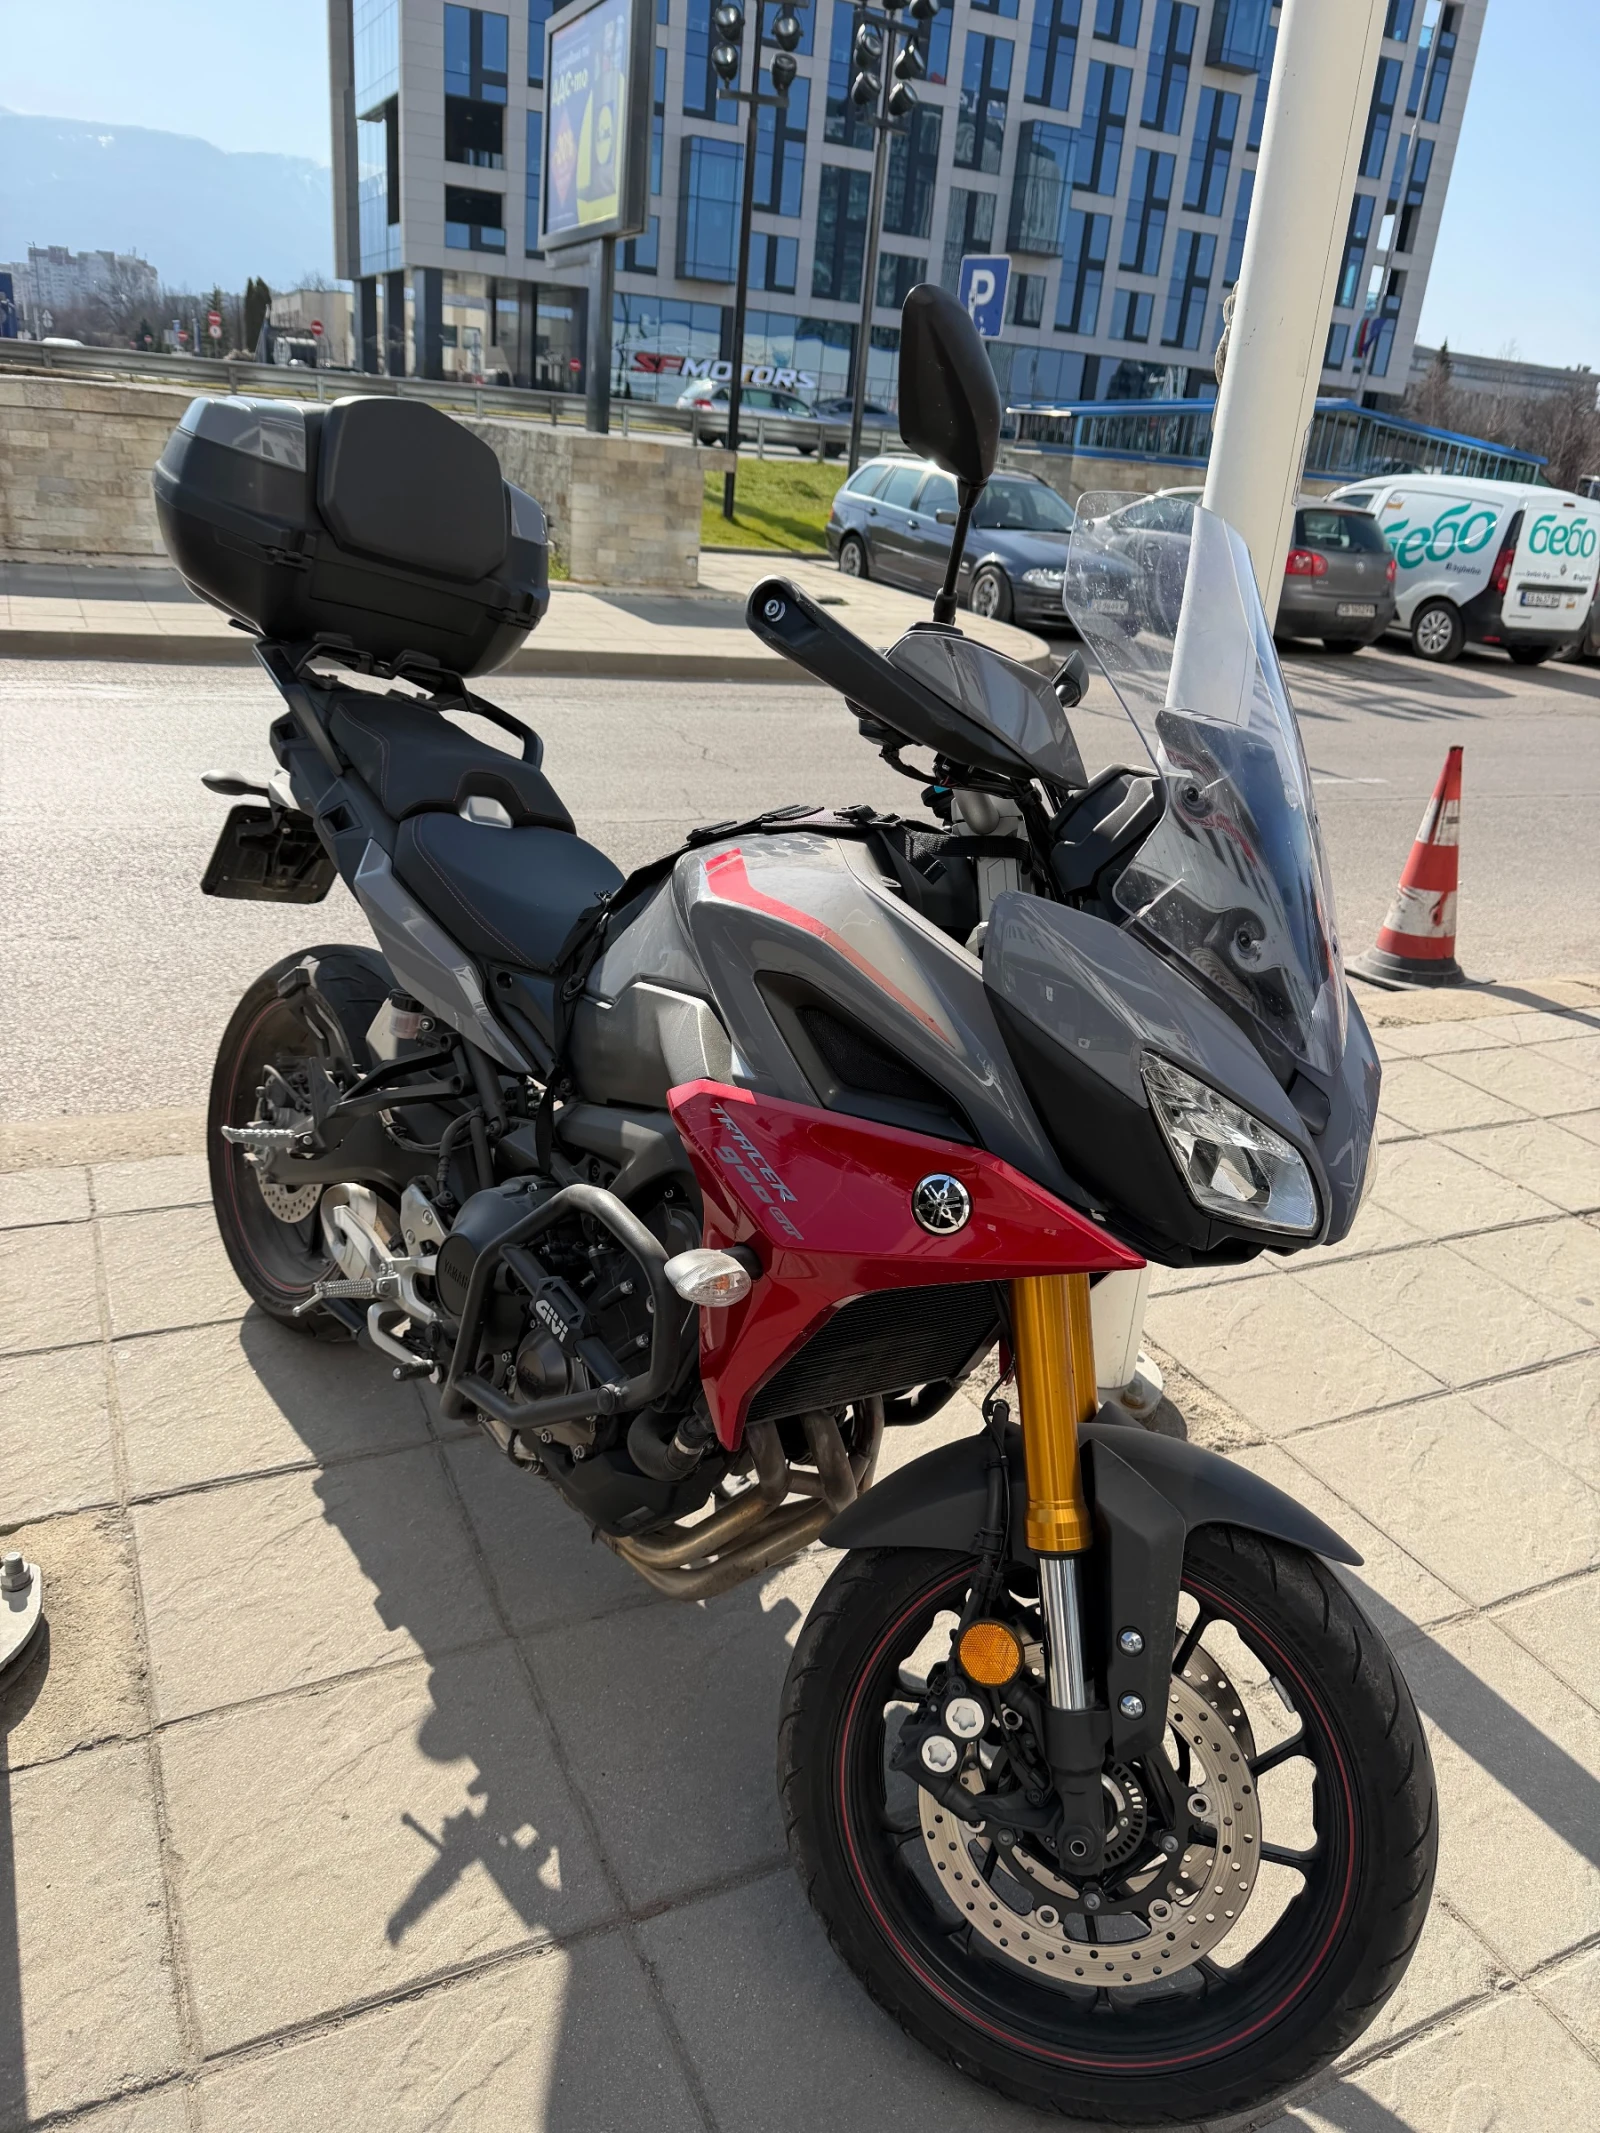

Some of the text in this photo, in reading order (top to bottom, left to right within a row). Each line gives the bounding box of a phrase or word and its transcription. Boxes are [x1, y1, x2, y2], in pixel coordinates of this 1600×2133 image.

[968, 269, 995, 320] P
[1529, 515, 1596, 558] бебо
[710, 1102, 798, 1202] TRACER
[713, 1146, 804, 1240] 900 GT
[444, 1258, 471, 1291] YAMAH
[535, 1300, 569, 1343] GIVI
